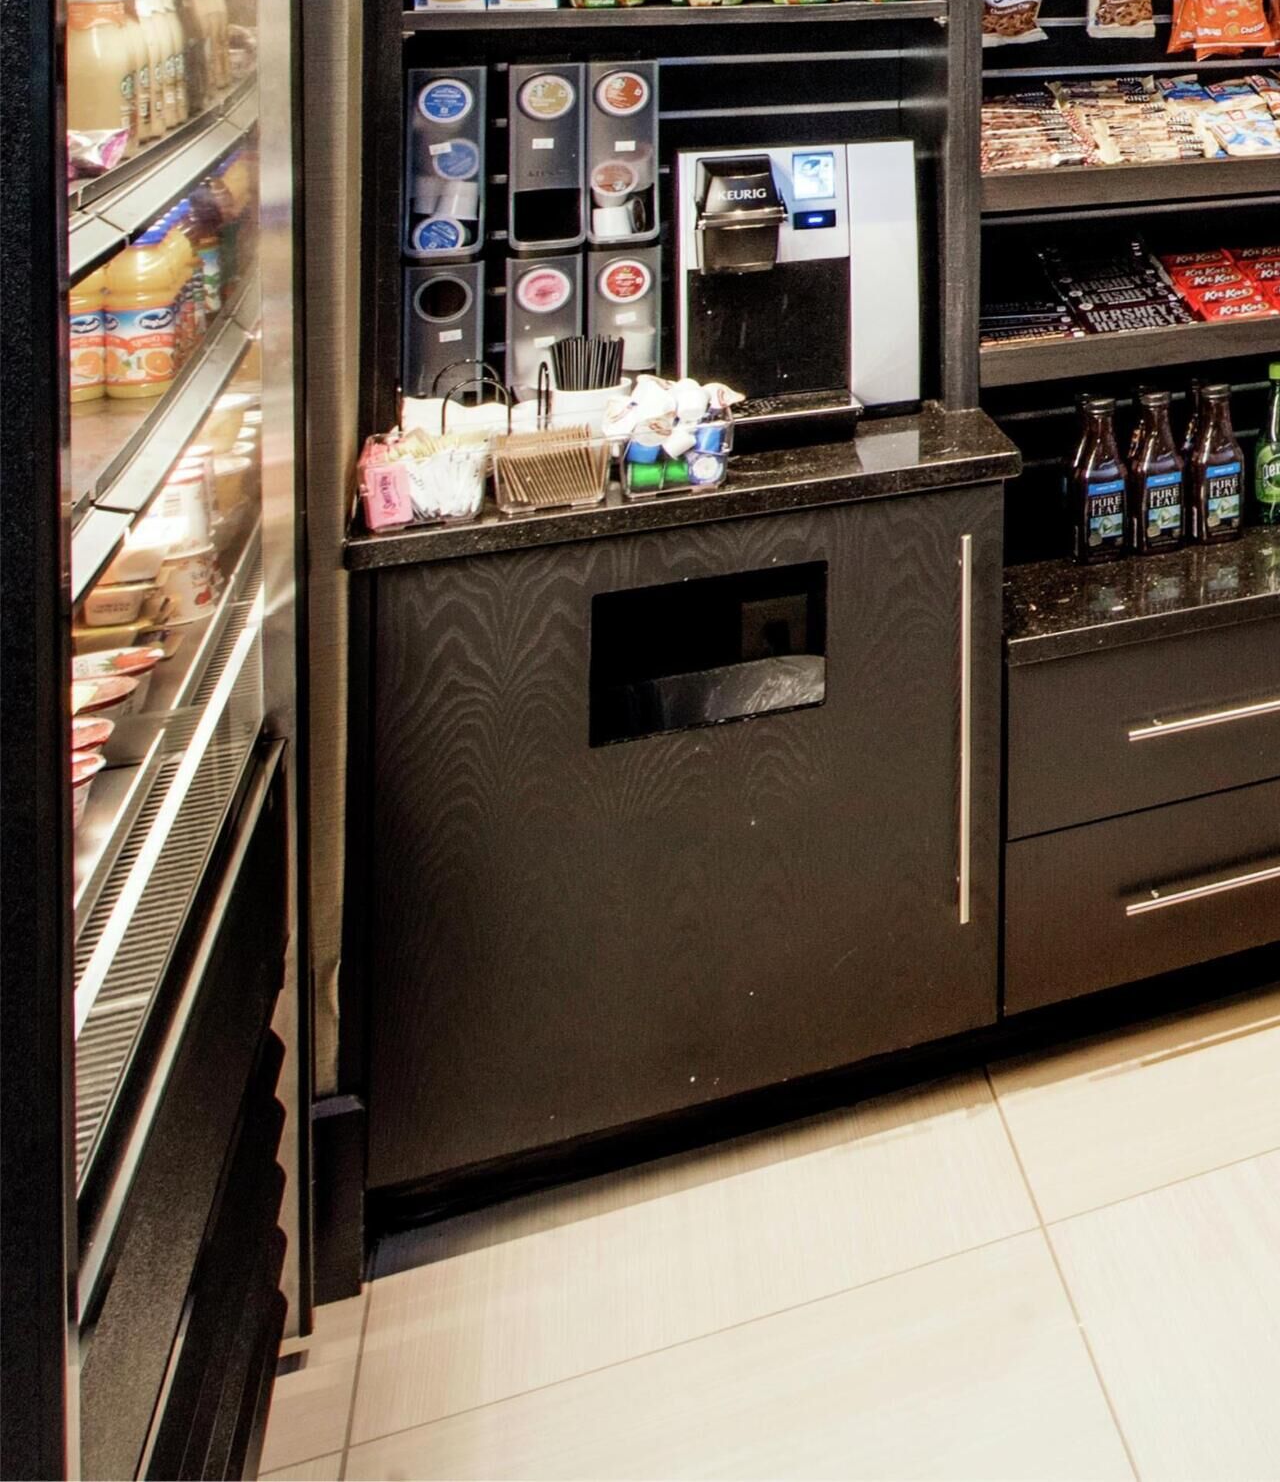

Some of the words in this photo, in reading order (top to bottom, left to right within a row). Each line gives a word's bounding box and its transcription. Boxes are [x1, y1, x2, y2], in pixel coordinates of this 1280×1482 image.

[717, 188, 767, 200] KEURIG
[1209, 478, 1239, 491] PURE
[1150, 487, 1180, 499] PURE
[1209, 486, 1237, 499] LEAF
[1091, 494, 1123, 507] PURE
[1150, 495, 1178, 508] LEAF
[1091, 504, 1122, 517] LEAF
